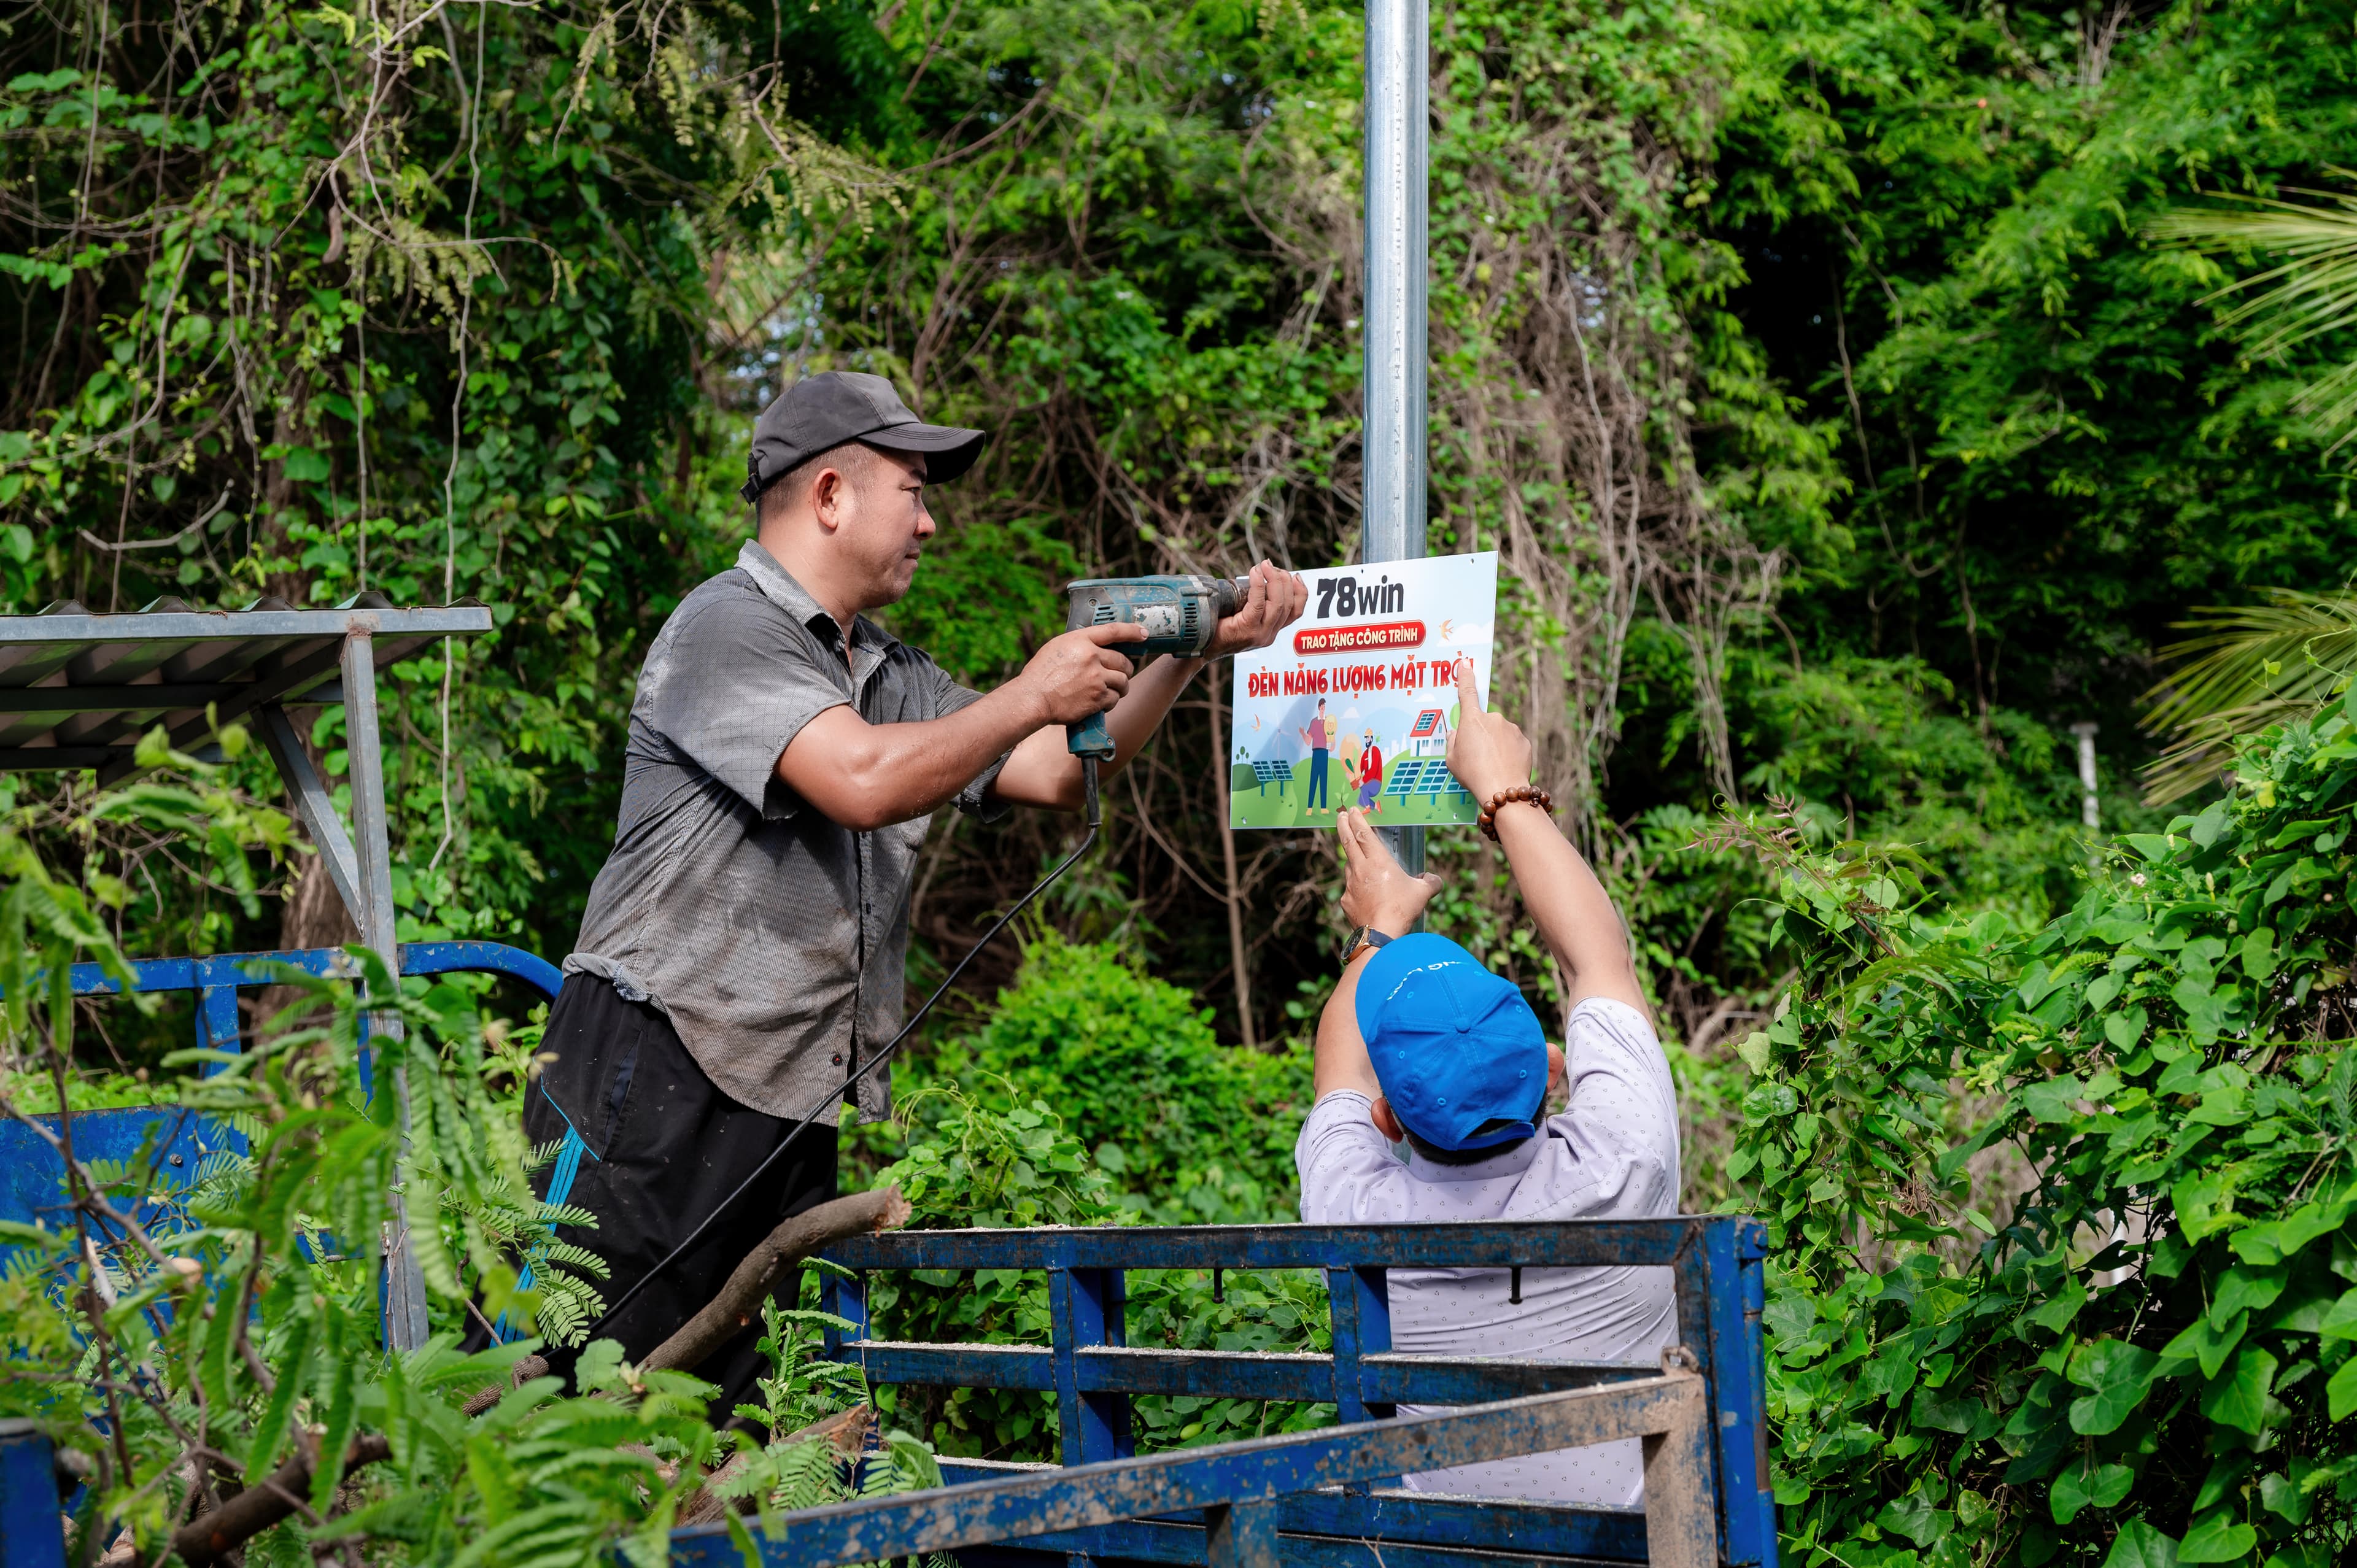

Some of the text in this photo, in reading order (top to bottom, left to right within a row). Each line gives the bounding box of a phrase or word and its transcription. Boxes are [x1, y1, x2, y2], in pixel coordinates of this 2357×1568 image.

[1394, 424, 1400, 455] 76
[1317, 575, 1404, 619] 78win
[1301, 625, 1418, 651] TRAO TẶNG CÔNG TRÌNH
[1248, 666, 1279, 698] ĐÈN
[1283, 662, 1327, 695] NĂNG
[1333, 663, 1385, 699] LƯỢNG
[1391, 654, 1426, 695] MẶT
